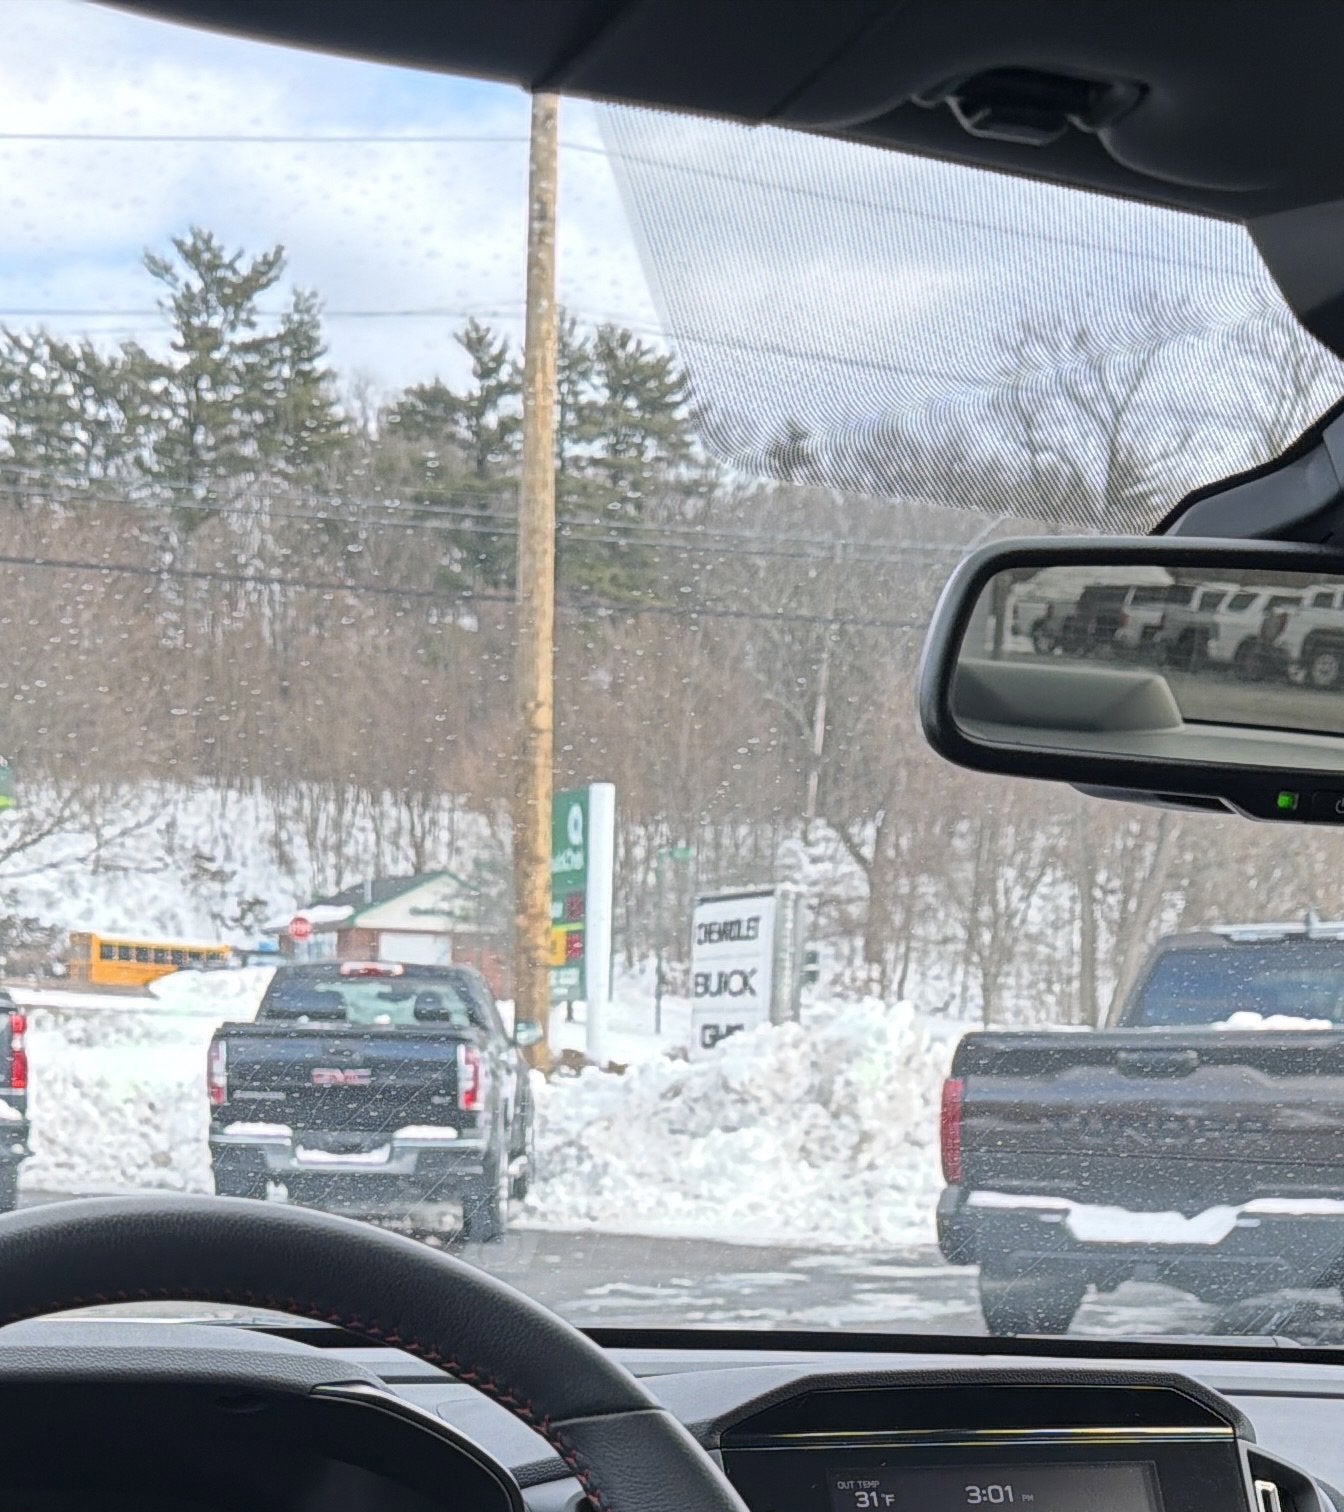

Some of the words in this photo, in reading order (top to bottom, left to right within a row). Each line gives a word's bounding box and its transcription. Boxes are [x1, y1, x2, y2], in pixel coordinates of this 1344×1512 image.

[694, 967, 758, 998] BUICK
[837, 1480, 855, 1490] OUT
[857, 1479, 880, 1489] TEMP
[965, 1484, 1015, 1505] 3:01
